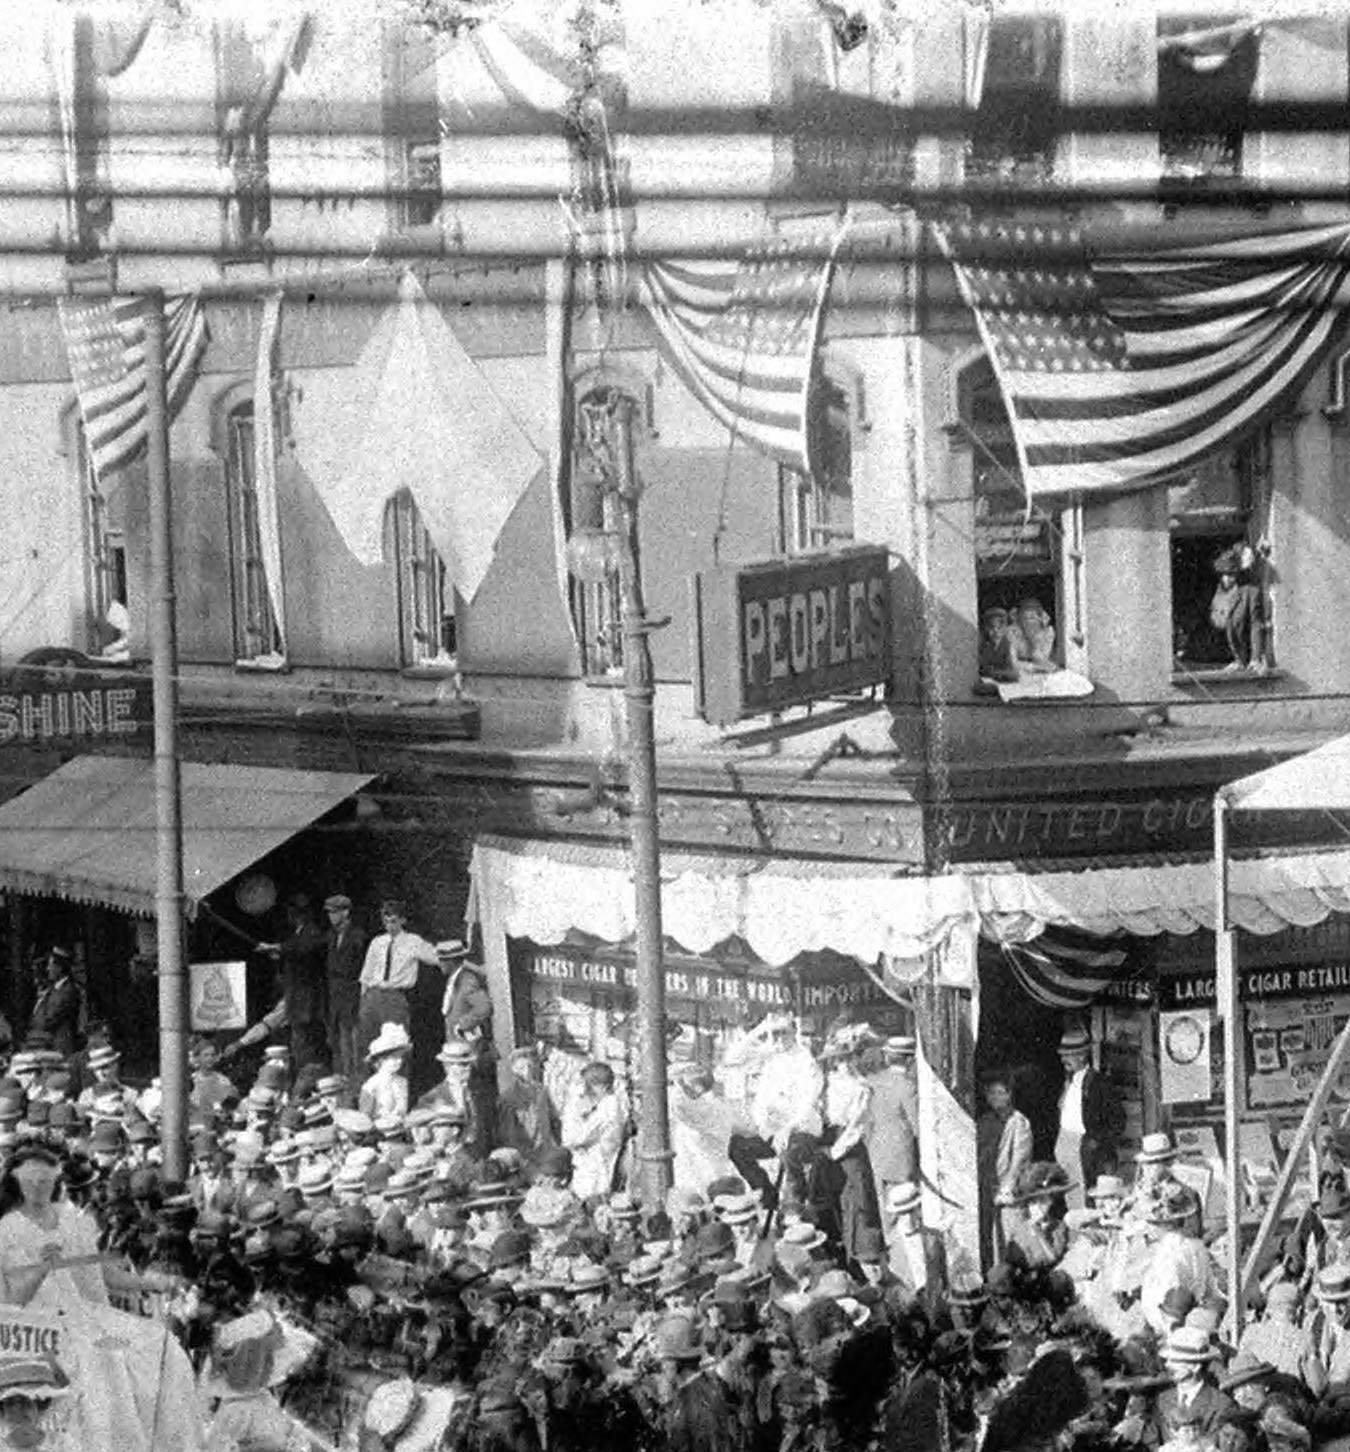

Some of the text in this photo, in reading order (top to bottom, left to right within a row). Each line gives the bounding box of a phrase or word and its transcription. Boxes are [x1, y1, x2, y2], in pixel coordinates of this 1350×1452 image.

[745, 577, 885, 686] PEOPLES
[948, 803, 1122, 846] UNITED
[526, 957, 575, 979] ARGEST
[1248, 971, 1293, 995] CIGAR
